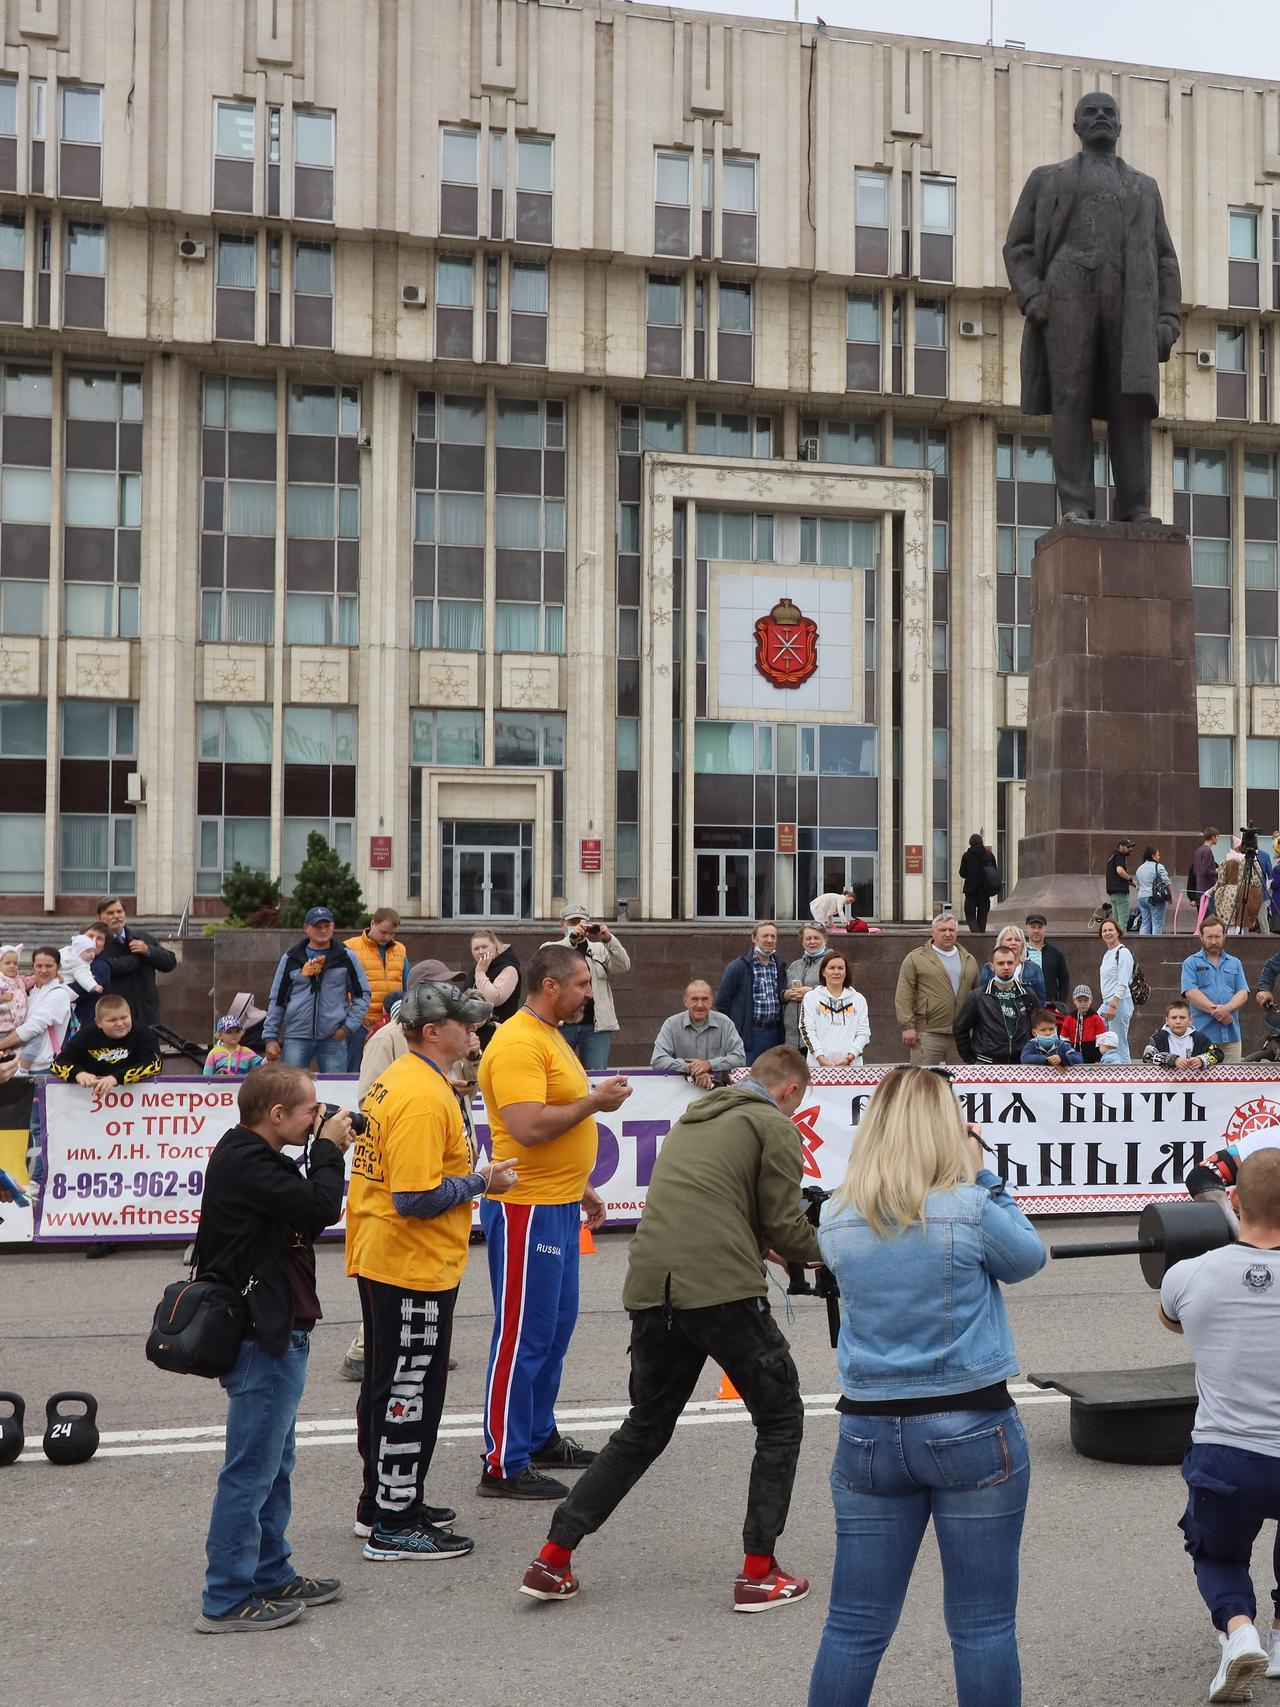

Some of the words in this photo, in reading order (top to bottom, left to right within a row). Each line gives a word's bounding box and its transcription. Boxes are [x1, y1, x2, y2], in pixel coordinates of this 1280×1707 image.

[90, 1091, 134, 1113] 300
[141, 1092, 233, 1113] метров
[1059, 1091, 1208, 1123] БЫТЬ
[105, 1121, 135, 1137] от
[141, 1116, 206, 1136] ТГПУ
[67, 1148, 102, 1161] им.
[107, 1143, 150, 1160] Л.Н.
[52, 1170, 204, 1200] 8-953-962-9
[607, 1201, 637, 1211] ВХОД
[51, 1422, 72, 1439] 24
